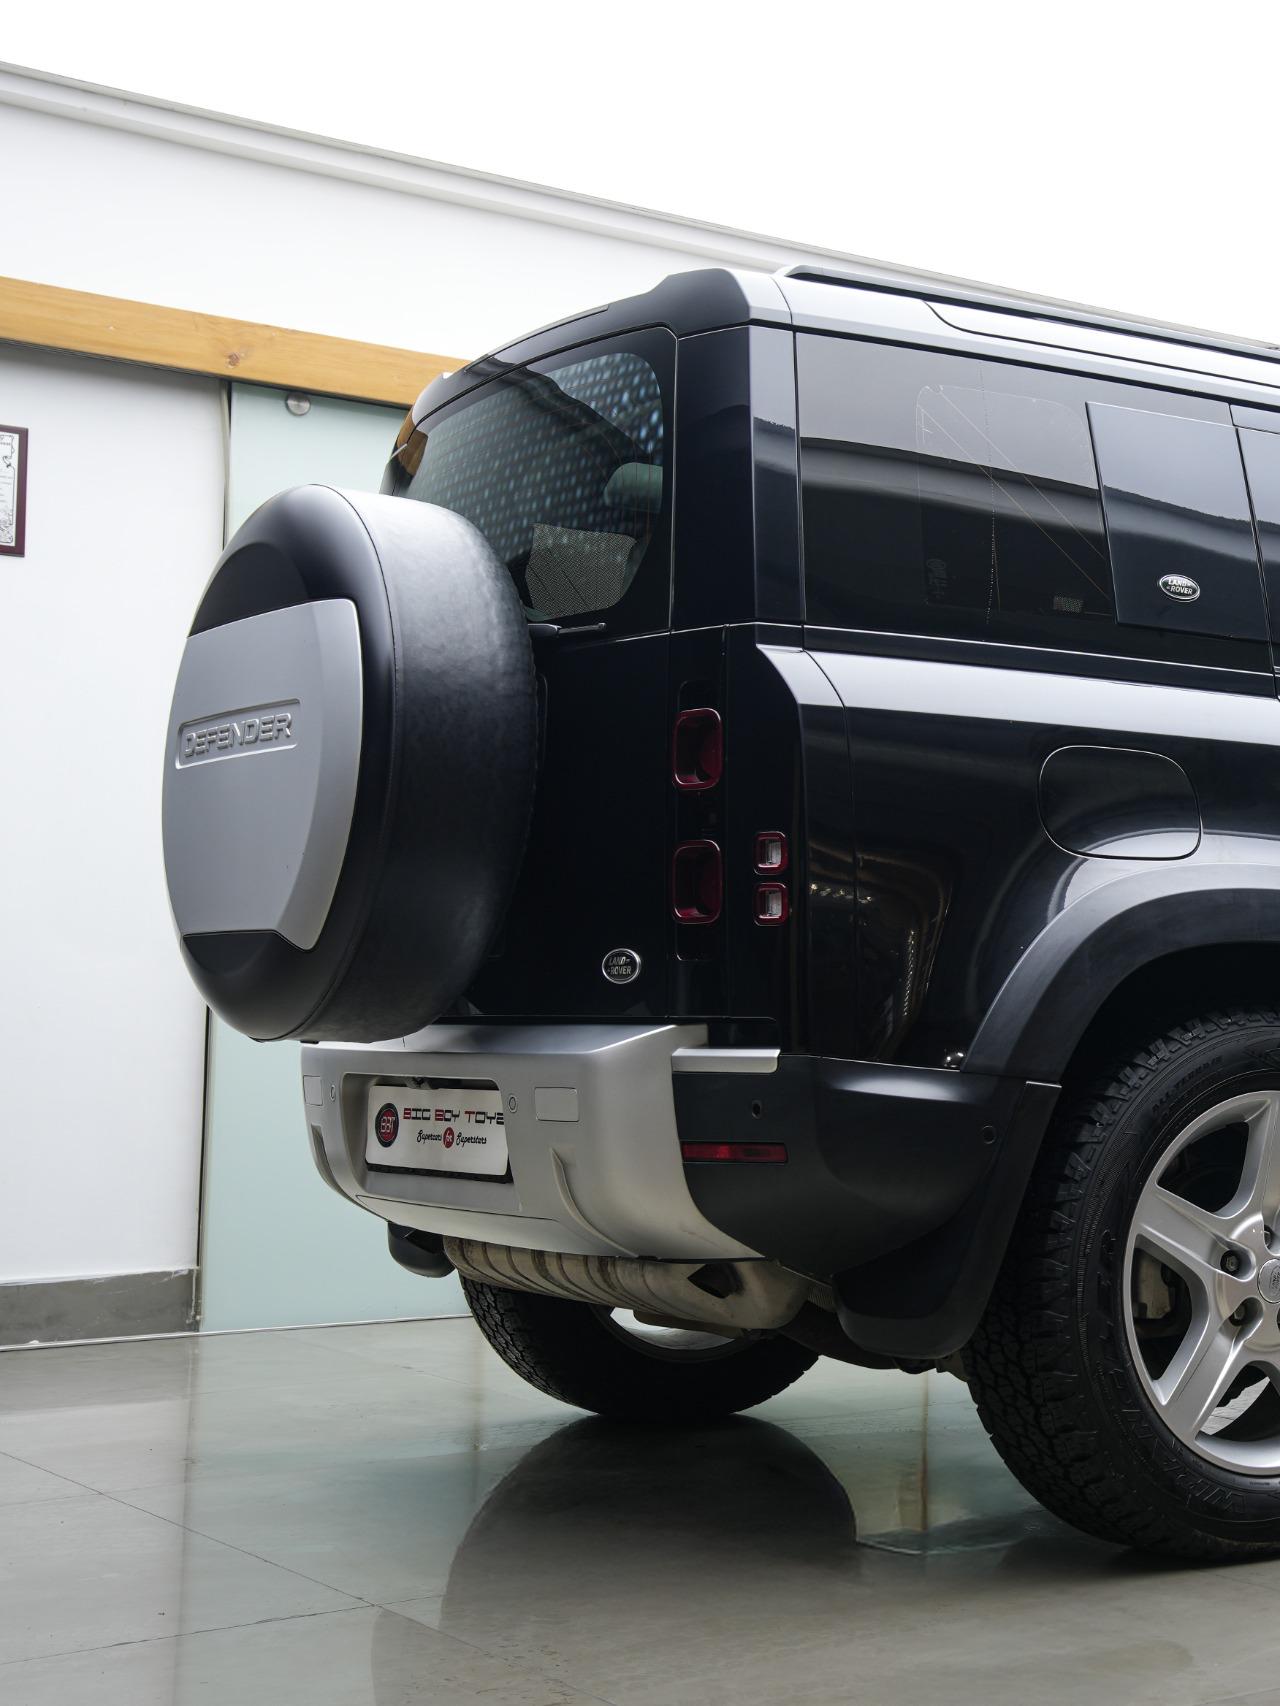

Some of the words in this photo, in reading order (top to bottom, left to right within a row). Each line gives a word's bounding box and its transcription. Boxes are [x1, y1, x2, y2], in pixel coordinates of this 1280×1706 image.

[1170, 586, 1193, 595] ROVER
[184, 712, 292, 758] DEFENDER
[608, 956, 626, 966] LAND
[610, 966, 631, 975] ROVER
[403, 1108, 431, 1121] BIG
[434, 1109, 461, 1123] BOY
[416, 1129, 443, 1144] Supercars
[456, 1131, 487, 1148] Superstars
